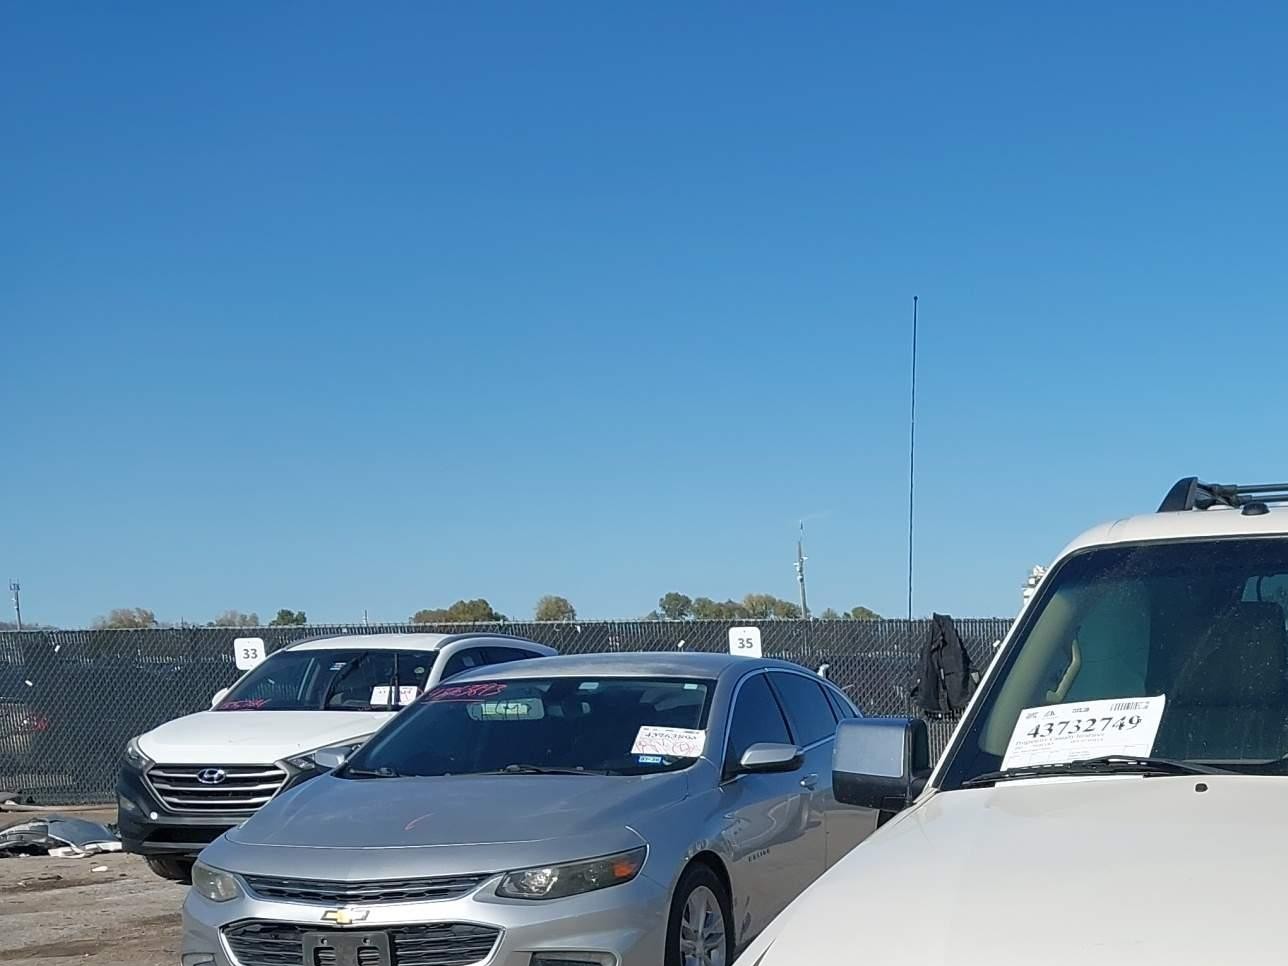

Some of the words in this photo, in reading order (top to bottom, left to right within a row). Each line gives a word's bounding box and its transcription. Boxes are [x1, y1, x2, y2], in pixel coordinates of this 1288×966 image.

[737, 638, 753, 649] 35
[242, 648, 258, 660] 33
[1027, 715, 1143, 738] 43732749
